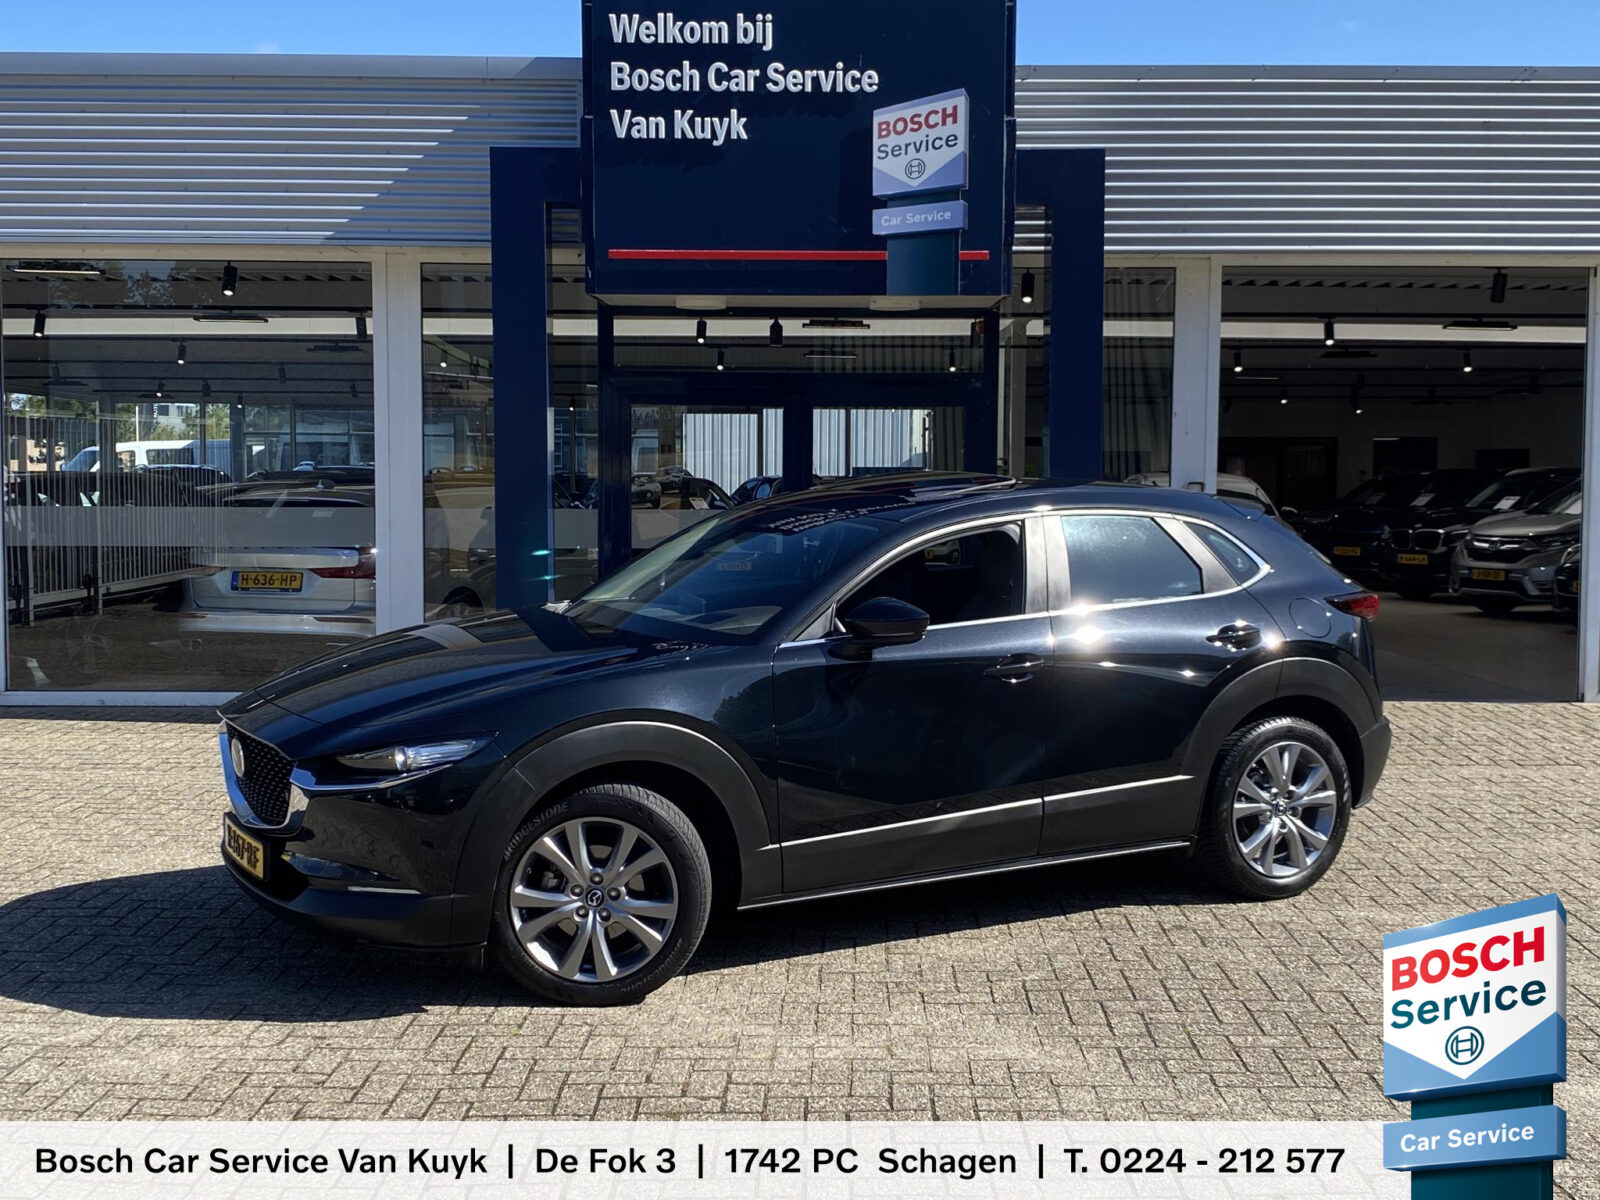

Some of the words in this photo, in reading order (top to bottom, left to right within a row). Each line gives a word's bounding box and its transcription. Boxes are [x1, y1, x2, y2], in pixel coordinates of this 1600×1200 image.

[609, 13, 729, 44] Welkom
[736, 13, 773, 51] bij
[610, 61, 700, 92] Bosch
[707, 62, 760, 92] Car
[766, 62, 879, 93] Service
[610, 109, 666, 139] Van
[674, 108, 748, 146] Kuyk
[877, 105, 958, 139] BOSCH
[877, 133, 958, 160] Service
[881, 215, 902, 226] Car
[906, 210, 951, 224] Service
[241, 574, 297, 586] H-636-HP
